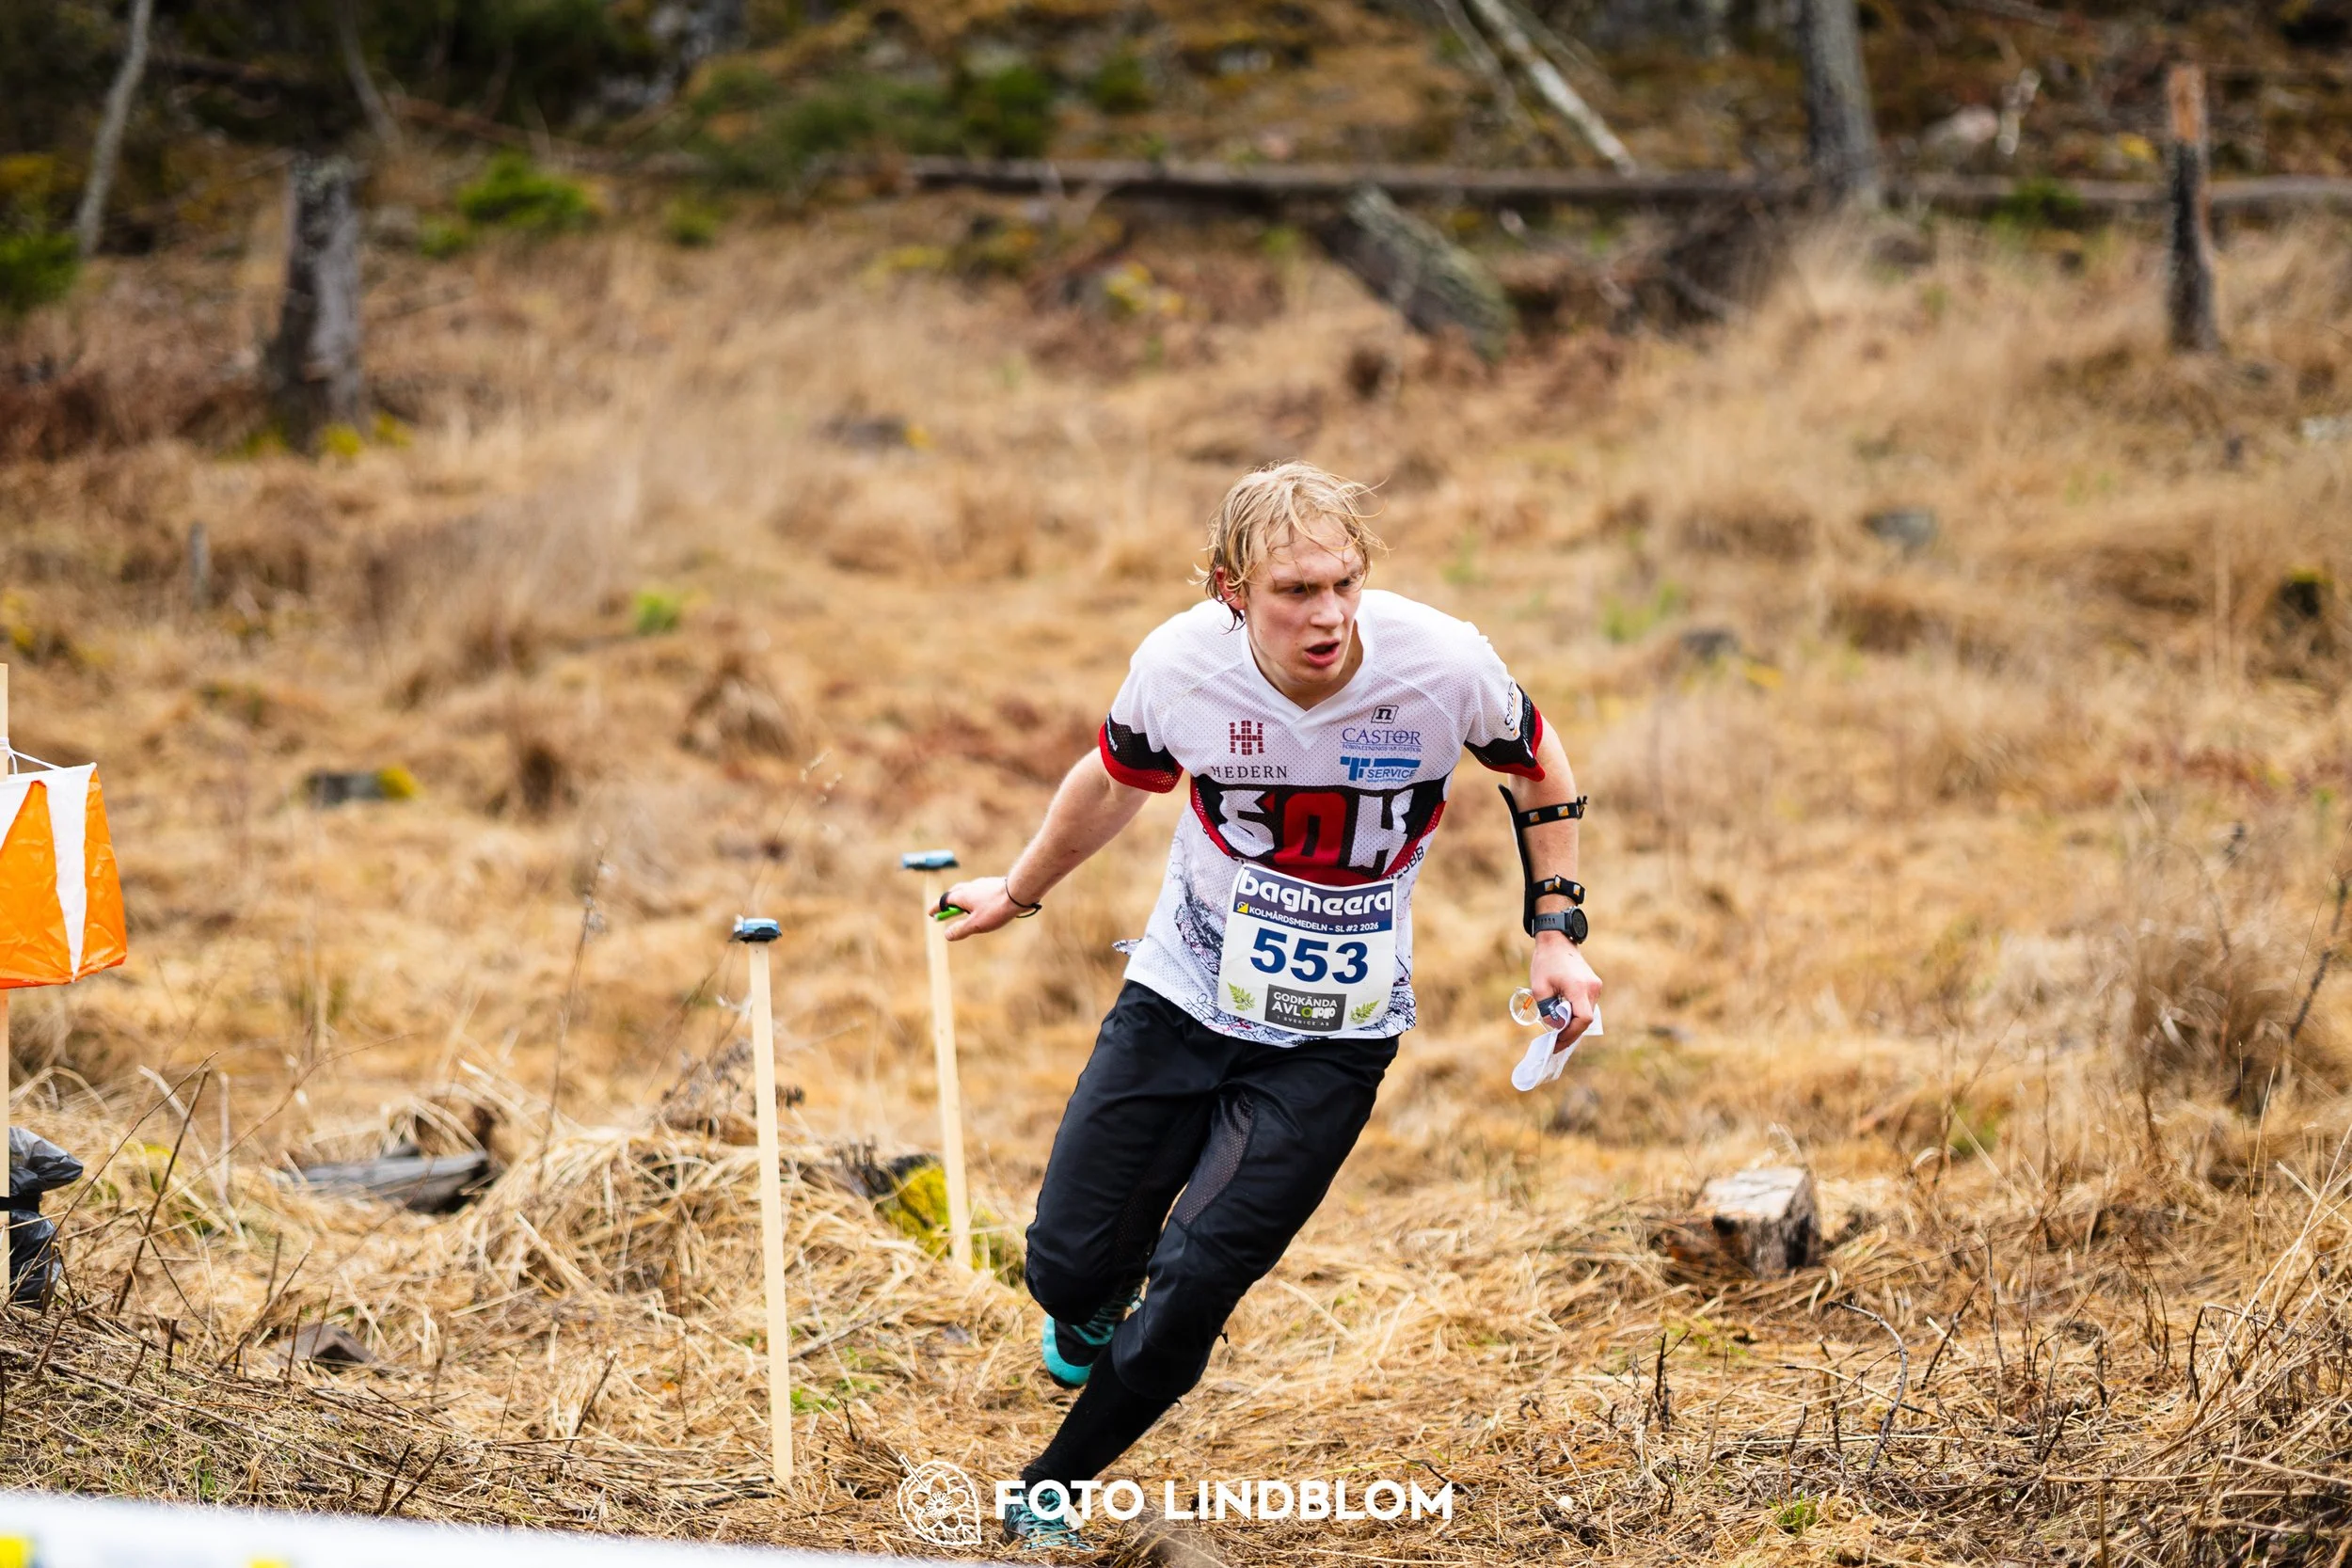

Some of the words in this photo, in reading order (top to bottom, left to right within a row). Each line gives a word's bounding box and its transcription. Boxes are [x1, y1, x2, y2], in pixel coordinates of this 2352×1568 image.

[1342, 727, 1422, 745] CASTOR
[1237, 868, 1392, 916] bagheera
[1249, 906, 1327, 931] KOLMÅRDSMEDELN
[1346, 924, 1359, 932] #2
[1359, 921, 1379, 931] 2026
[1249, 927, 1369, 984] 553
[1273, 991, 1338, 1007] GODKÄNDA
